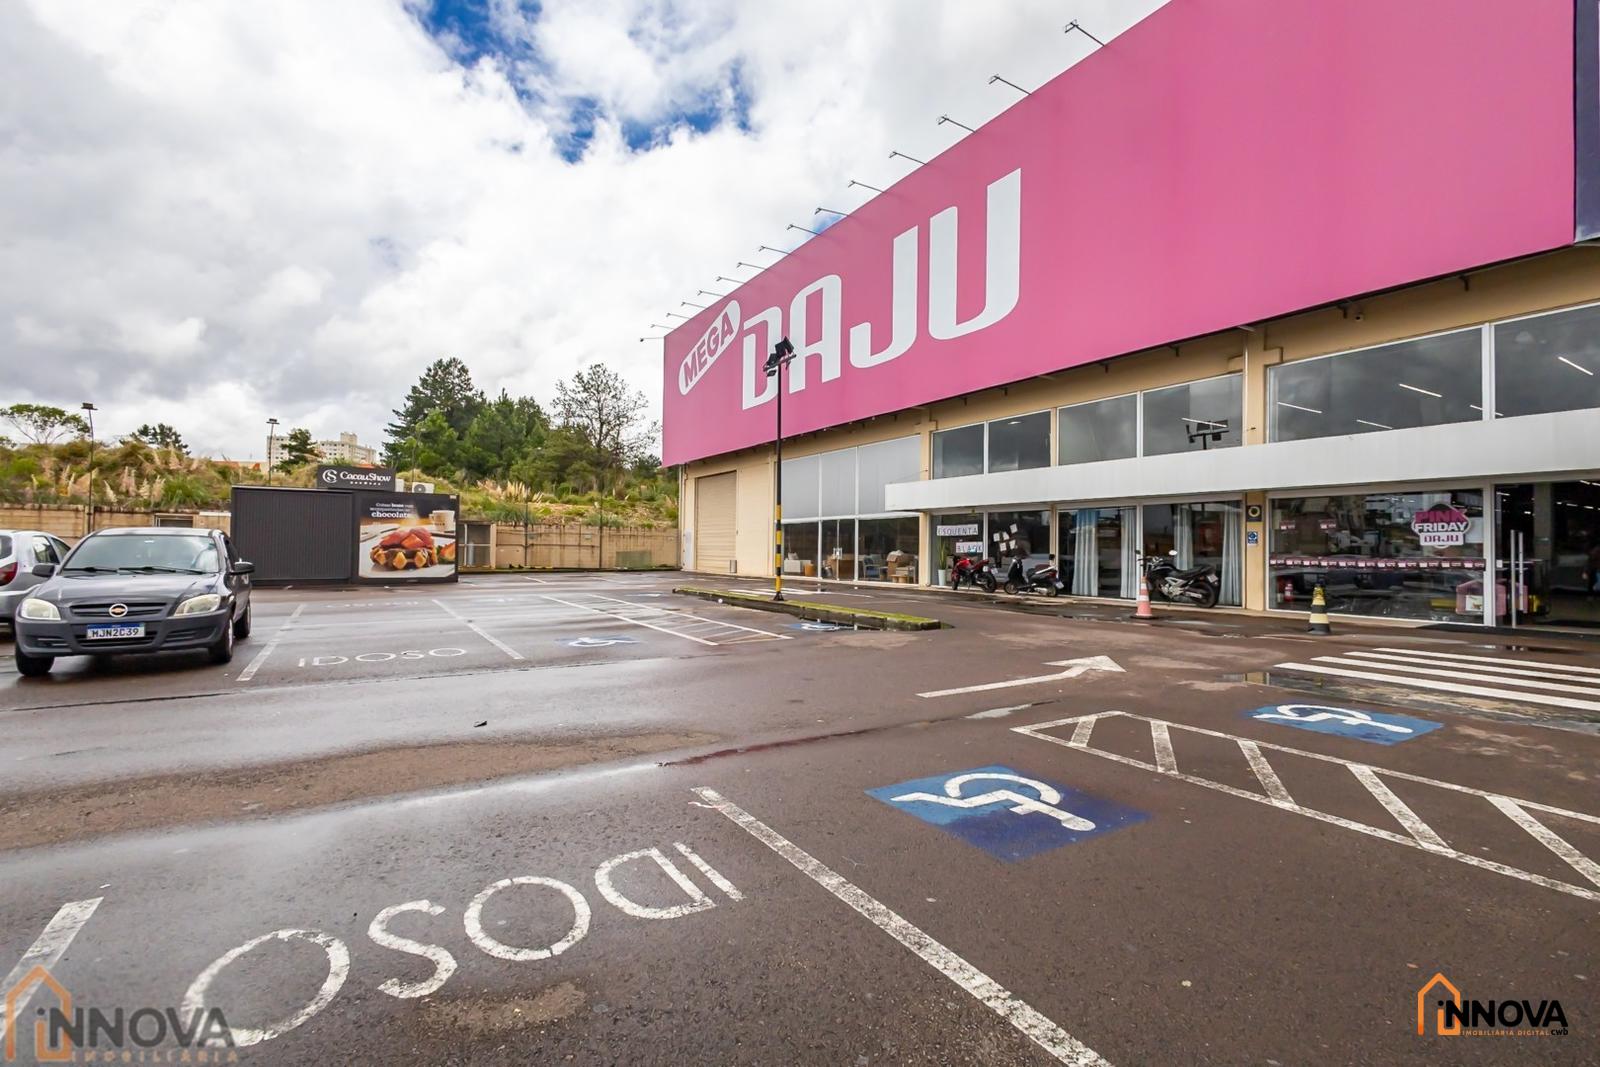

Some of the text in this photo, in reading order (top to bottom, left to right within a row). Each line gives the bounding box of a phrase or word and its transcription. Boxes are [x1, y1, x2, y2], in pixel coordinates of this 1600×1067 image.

[683, 168, 1021, 411] MEGA DAJU
[1415, 510, 1467, 523] PINK
[937, 526, 977, 535] ESQUENTA
[1415, 522, 1467, 532] FRIDAY
[1424, 535, 1459, 543] DAJU
[298, 648, 466, 667] IDOSO
[181, 842, 745, 1046] IDOSO
